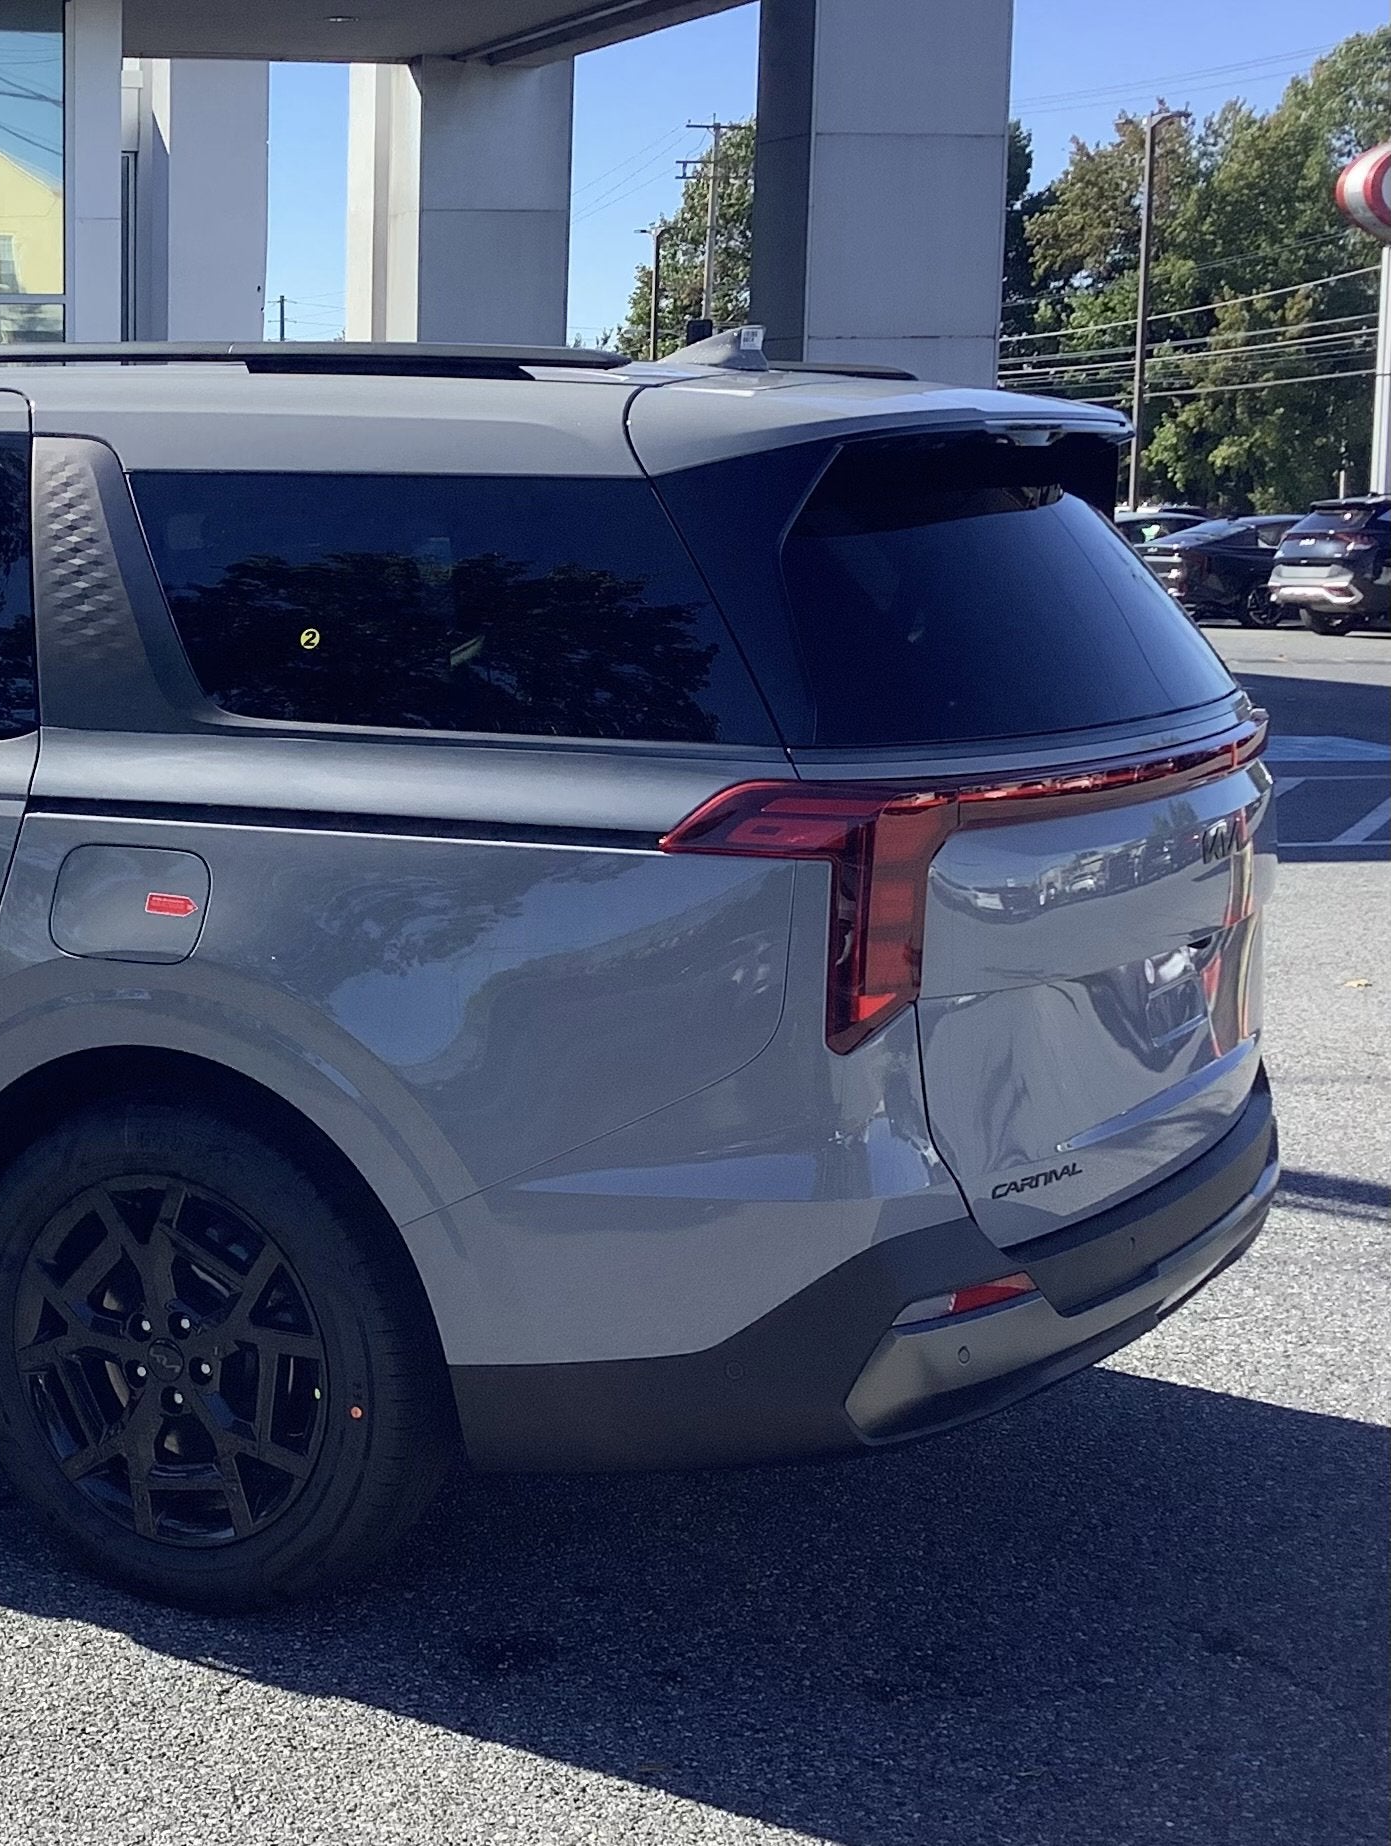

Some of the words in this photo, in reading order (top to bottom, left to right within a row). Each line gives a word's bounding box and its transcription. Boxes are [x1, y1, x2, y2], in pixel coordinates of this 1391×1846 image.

[303, 630, 317, 646] 2
[1202, 820, 1240, 864] KIA
[991, 1162, 1083, 1200] CARNIVAL
